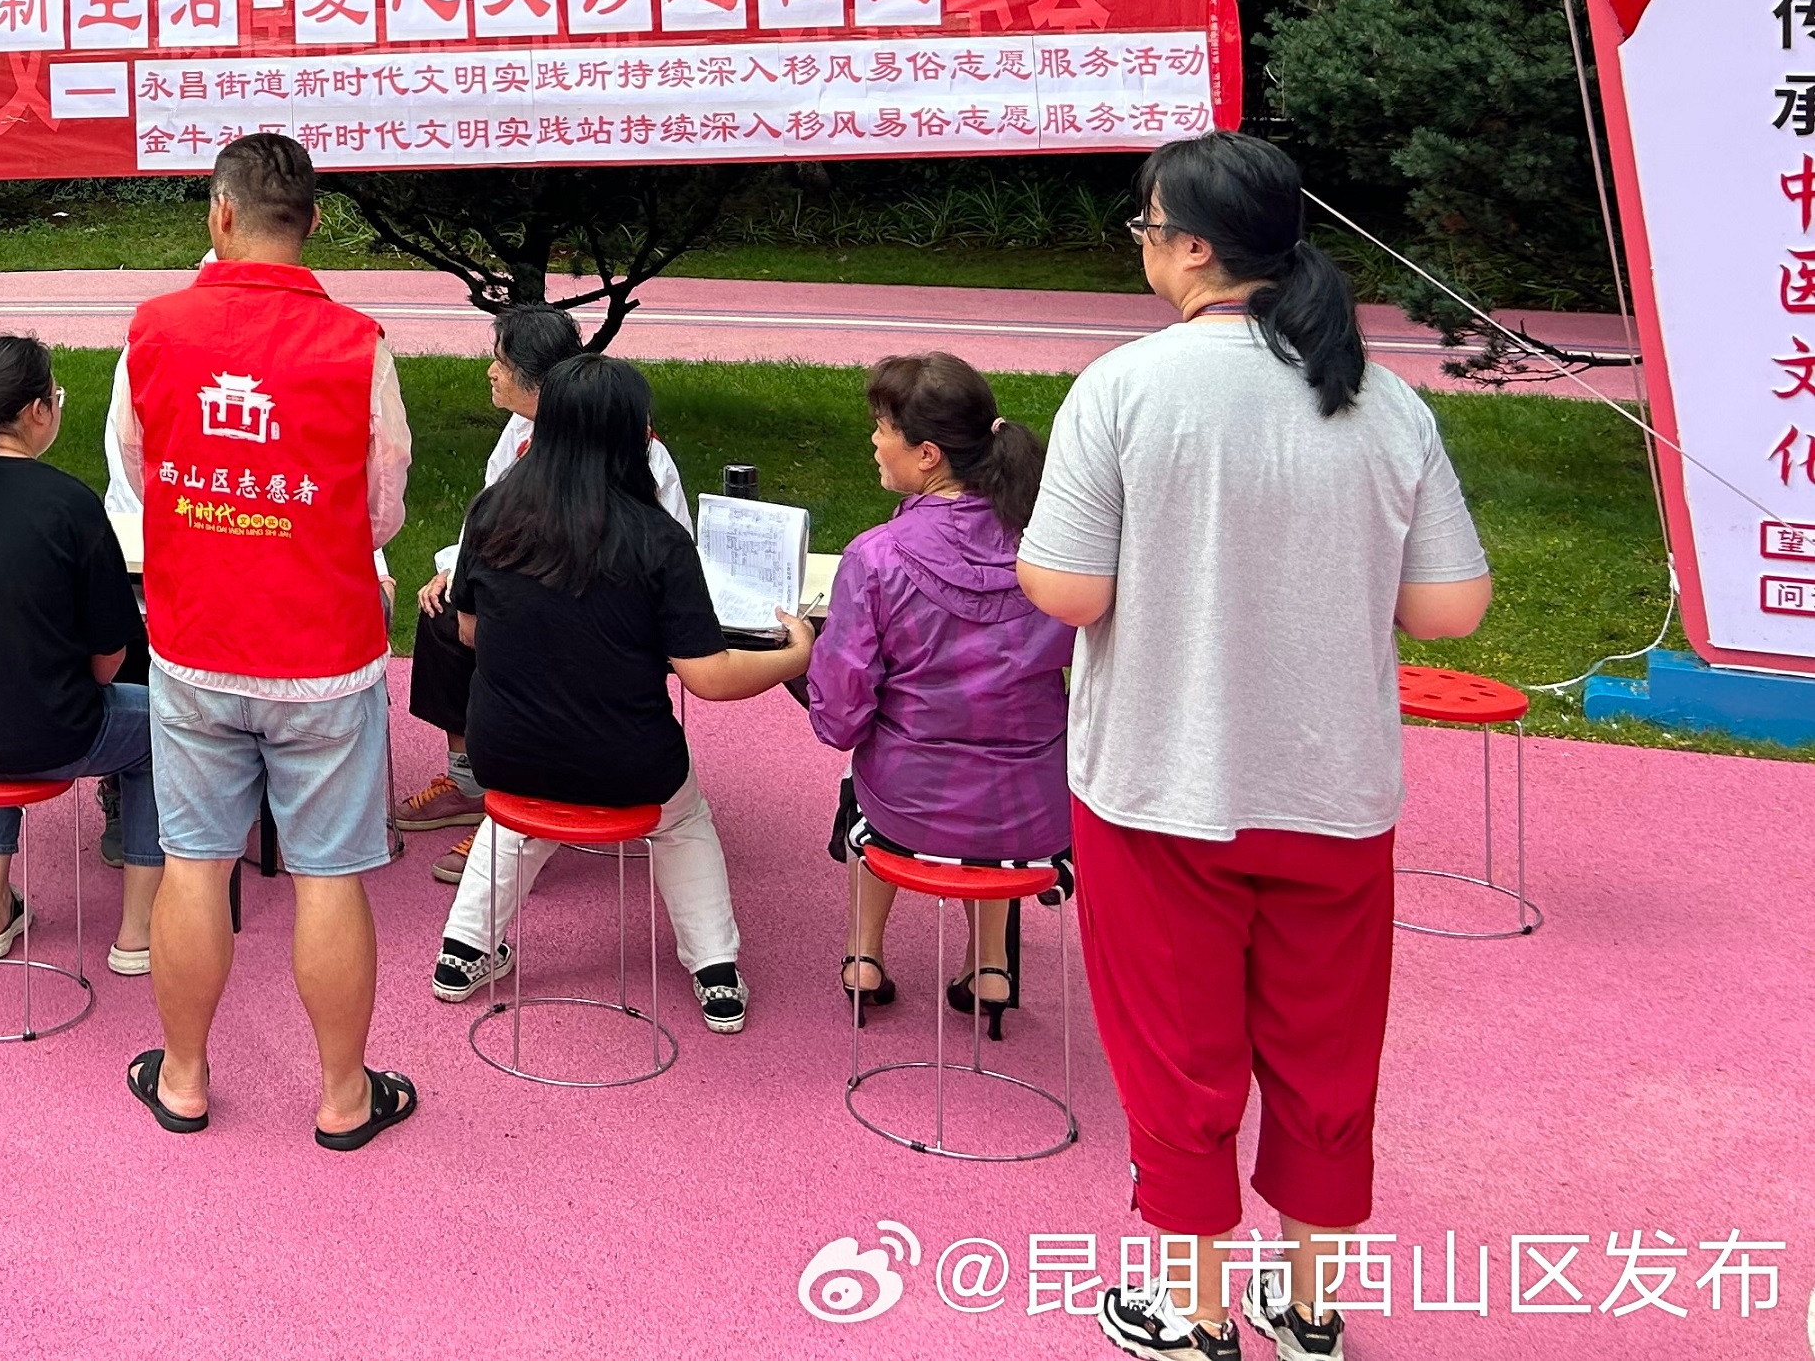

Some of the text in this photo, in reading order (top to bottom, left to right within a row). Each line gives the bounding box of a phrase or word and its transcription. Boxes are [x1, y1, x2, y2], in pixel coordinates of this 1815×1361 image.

[159, 460, 319, 506] 西山区志愿者
[1776, 529, 1815, 553] 望
[1777, 583, 1815, 609] 问
